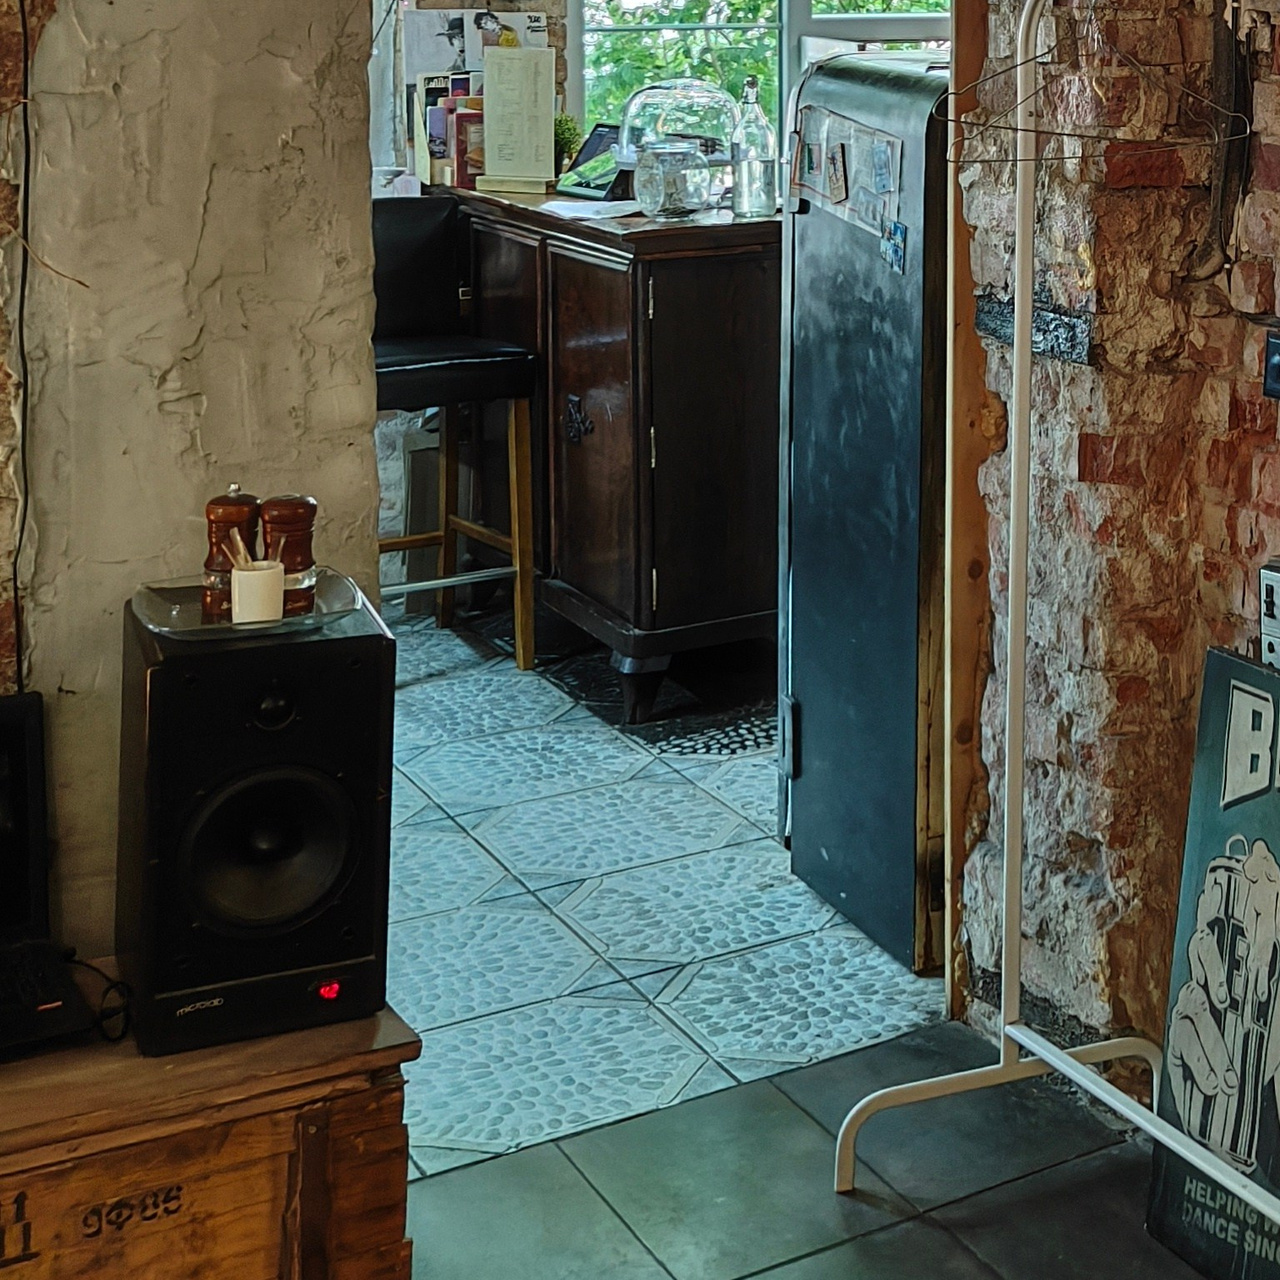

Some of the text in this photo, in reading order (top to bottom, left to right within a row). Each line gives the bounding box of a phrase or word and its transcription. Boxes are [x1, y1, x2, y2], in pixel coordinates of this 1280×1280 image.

[176, 996, 224, 1017] microlab
[1184, 1175, 1258, 1225] HELPING
[1182, 1201, 1239, 1246] DANCE
